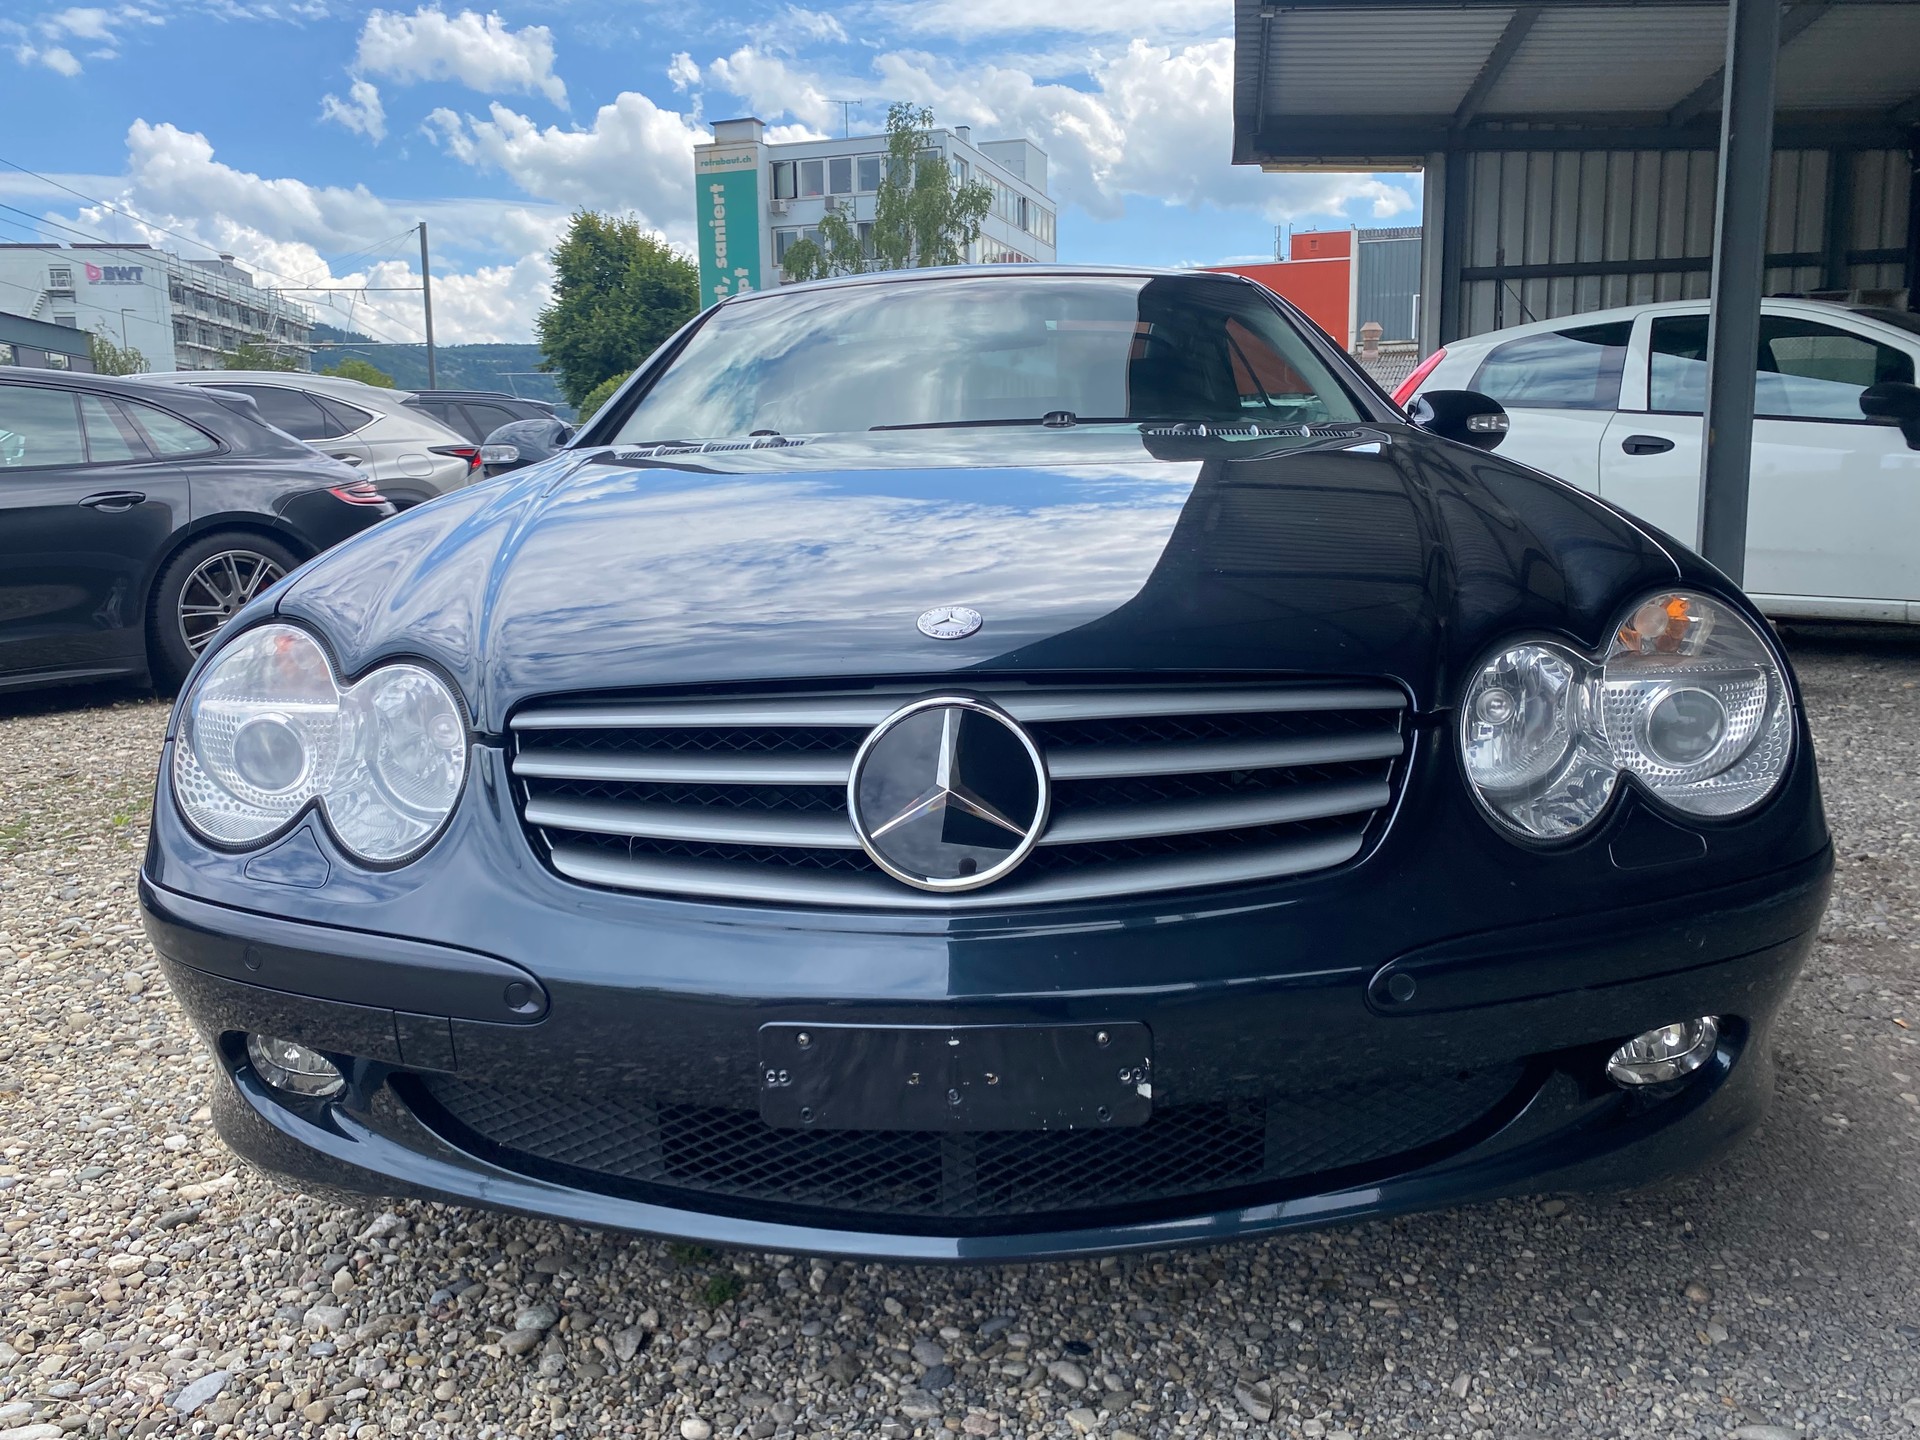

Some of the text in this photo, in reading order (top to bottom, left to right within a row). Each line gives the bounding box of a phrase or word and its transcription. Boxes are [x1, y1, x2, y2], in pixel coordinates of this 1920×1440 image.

[700, 155, 752, 167] rotrabaut.ch
[709, 184, 728, 268] saniert
[103, 266, 143, 281] BWT
